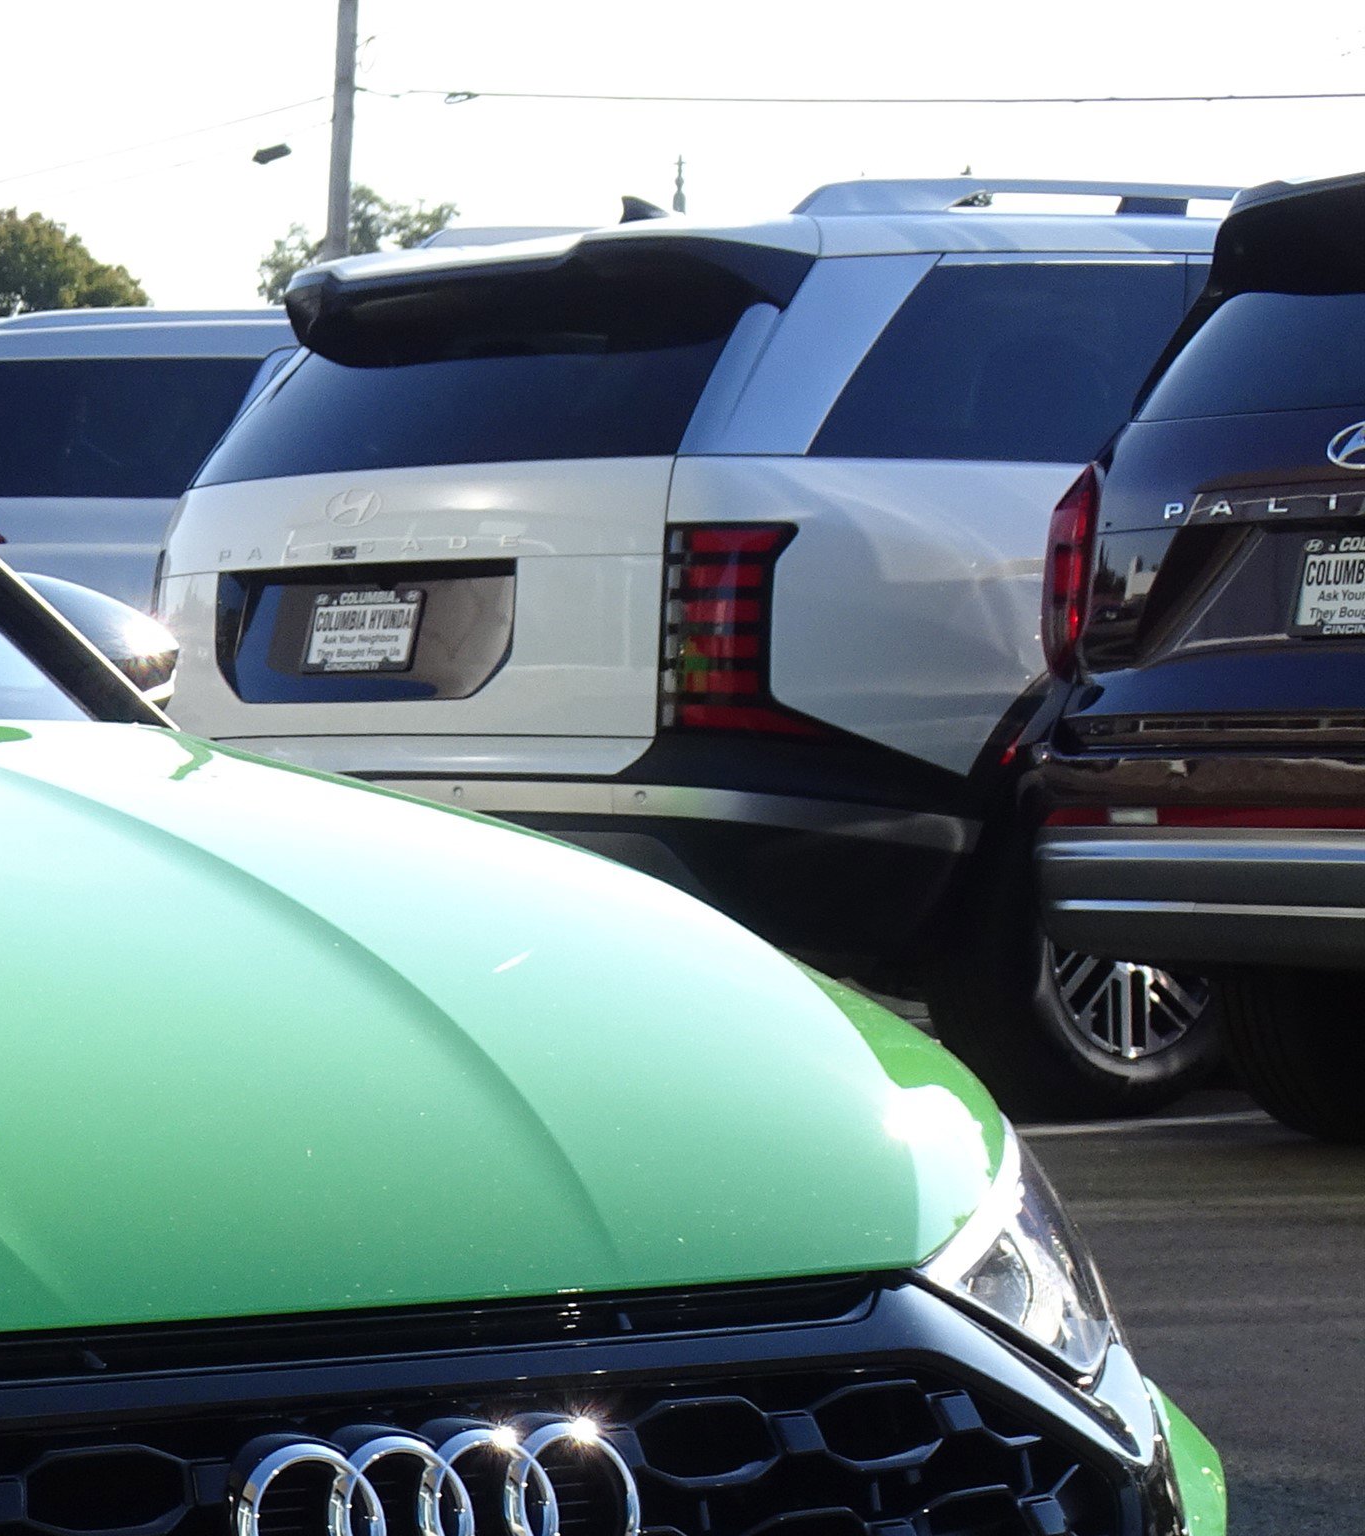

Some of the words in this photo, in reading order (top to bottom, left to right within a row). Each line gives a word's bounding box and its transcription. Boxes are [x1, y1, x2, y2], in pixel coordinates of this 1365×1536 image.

[339, 591, 395, 605] COLUMBIA
[1317, 590, 1339, 601] Ask
[1309, 606, 1336, 621] They
[316, 609, 368, 632] COLUMBIA
[323, 635, 337, 644] Ask
[339, 635, 356, 643] Your
[358, 634, 399, 645] Neighbors
[317, 650, 334, 659] They
[336, 648, 366, 660] Bought
[367, 647, 388, 657] From
[389, 647, 400, 656] Us
